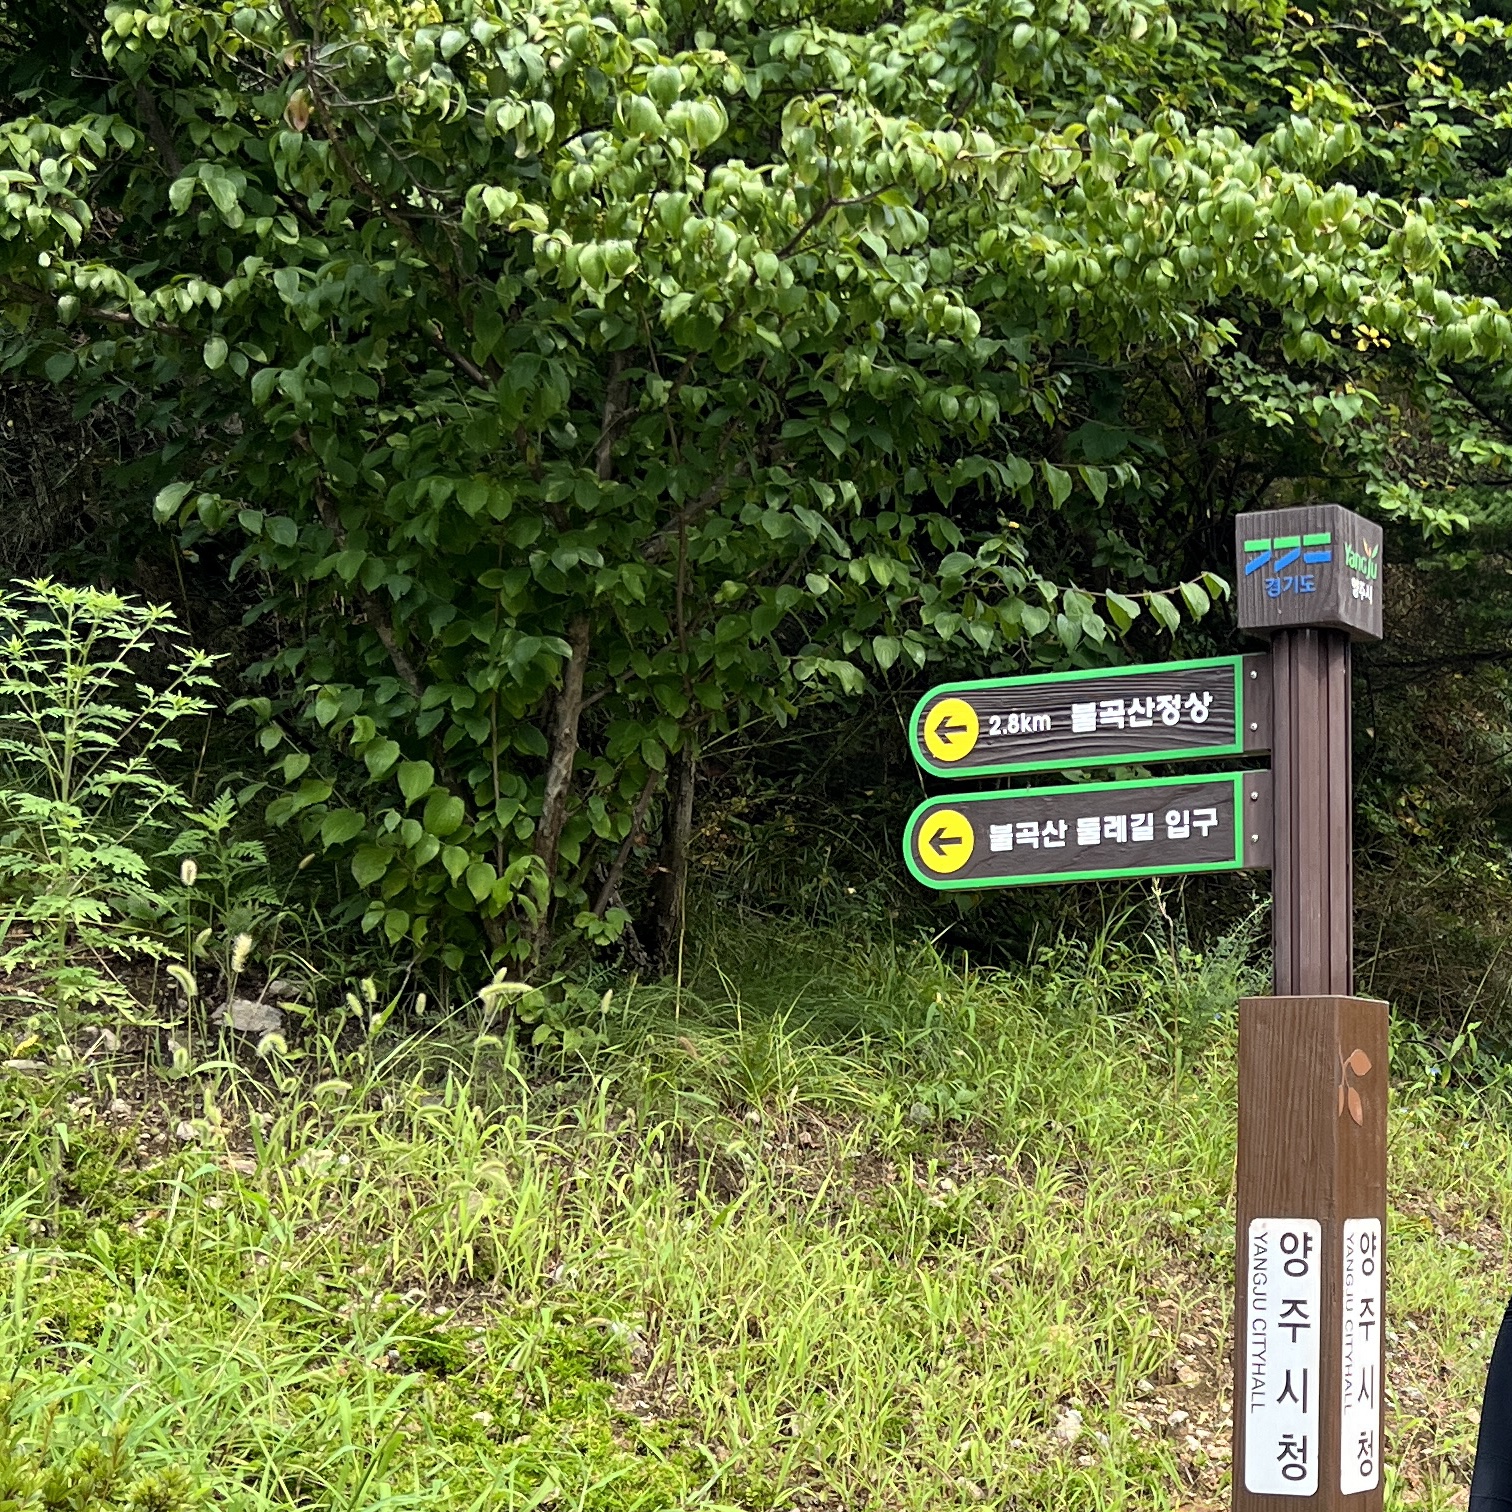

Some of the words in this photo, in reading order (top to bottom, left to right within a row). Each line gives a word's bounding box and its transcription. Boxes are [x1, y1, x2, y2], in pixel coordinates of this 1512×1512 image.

[1265, 574, 1316, 598] 경기도
[1351, 577, 1373, 605] 양주시
[989, 713, 1051, 736] 2.8km
[1071, 691, 1213, 733] 불곡산정상
[989, 819, 1068, 851] 불곡산
[1077, 813, 1154, 845] 둘레길
[1165, 808, 1218, 839] 입구
[1252, 1231, 1268, 1312] YANGJU
[1344, 1233, 1355, 1312] YANGJU
[1250, 1318, 1267, 1414] CITYHALL
[1276, 1231, 1313, 1482] 양주시청
[1357, 1231, 1377, 1478] 양주시청
